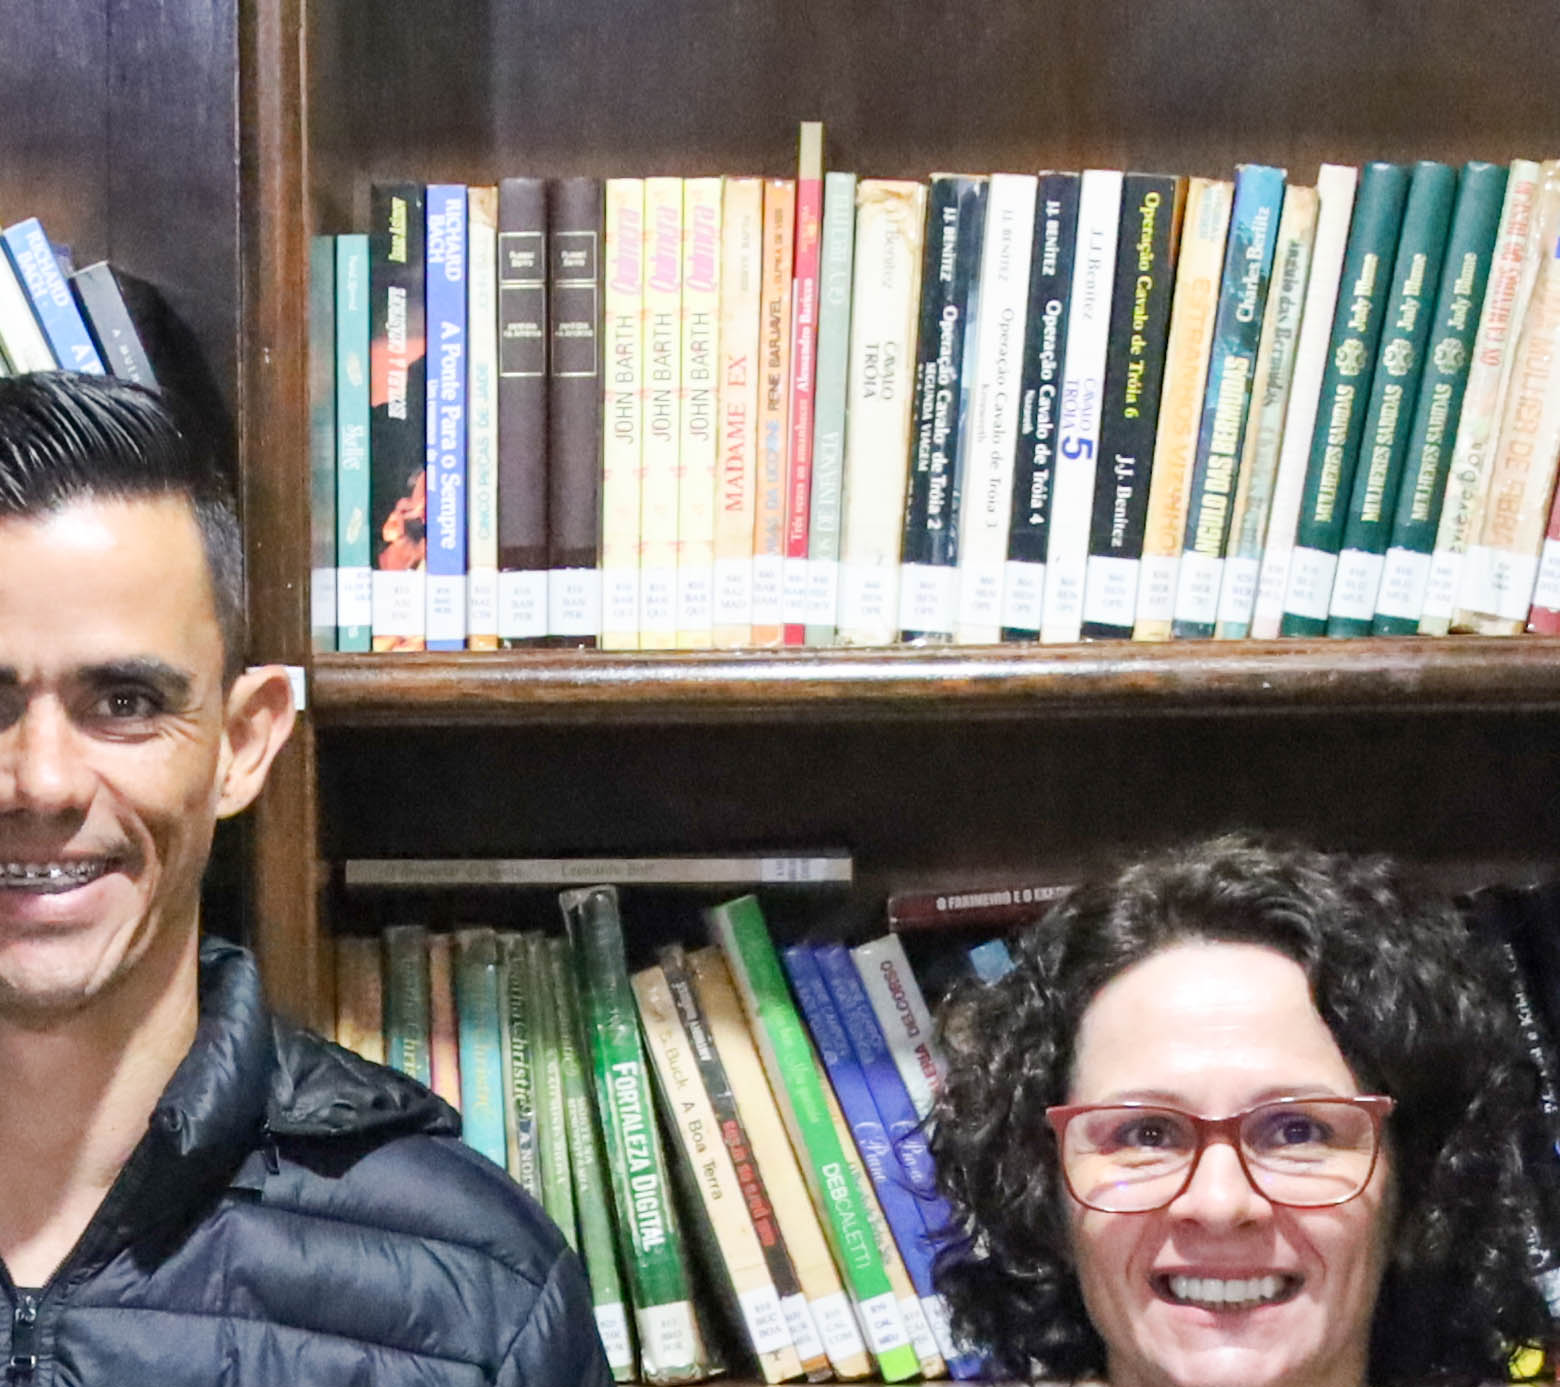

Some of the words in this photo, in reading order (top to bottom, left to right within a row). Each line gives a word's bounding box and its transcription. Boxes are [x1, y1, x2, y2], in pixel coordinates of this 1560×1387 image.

[427, 214, 445, 263] BACH
[443, 199, 462, 280] RICHARD
[1134, 191, 1162, 271] Operação
[1245, 205, 1272, 260] Berlitz
[13, 248, 52, 300] BACH
[19, 228, 74, 308] RICHARD
[1234, 260, 1262, 323] Charles
[1131, 274, 1153, 331] Cavalo
[1394, 295, 1420, 333] Judy
[1445, 295, 1470, 331] Judy
[614, 314, 633, 382] BARTH
[652, 313, 672, 380] BARTH
[689, 312, 710, 379] BARTH
[727, 354, 746, 387] EX
[1129, 334, 1146, 356] de
[440, 346, 461, 400] Ponte
[441, 405, 460, 450] Para
[614, 391, 634, 444] JOHN
[650, 389, 671, 441] JOHN
[689, 388, 710, 440] JOHN
[932, 389, 952, 445] Cavalo
[1035, 384, 1056, 440] Cavalo
[1209, 355, 1251, 455] BERMUDAS
[721, 403, 749, 512] MADAME
[1034, 443, 1051, 465] de
[436, 472, 461, 548] Sempre
[661, 1046, 690, 1092] Buck
[604, 1058, 659, 1173] FORTALEZA
[680, 1099, 695, 1113] A
[685, 1118, 708, 1154] Boa
[699, 1159, 725, 1201] Terra
[625, 1171, 674, 1255] DIGITAL
